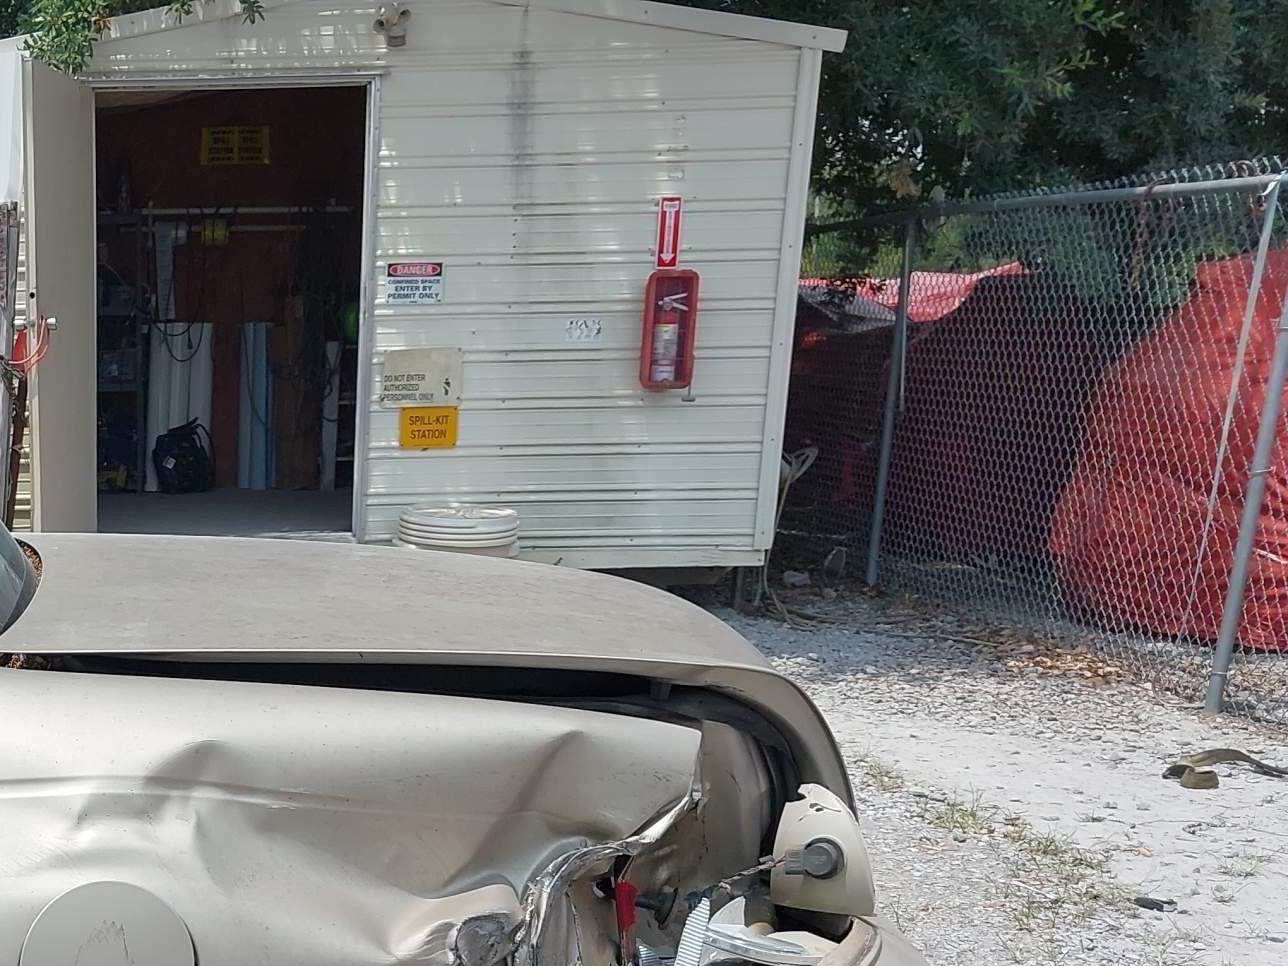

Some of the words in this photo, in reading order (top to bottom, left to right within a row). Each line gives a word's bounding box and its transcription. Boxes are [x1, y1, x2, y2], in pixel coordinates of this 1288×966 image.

[394, 374, 406, 382] NOT
[407, 373, 425, 382] ENTER
[419, 393, 433, 401] ONLY
[409, 415, 449, 425] SPILL-KIT
[410, 429, 446, 440] STATION
